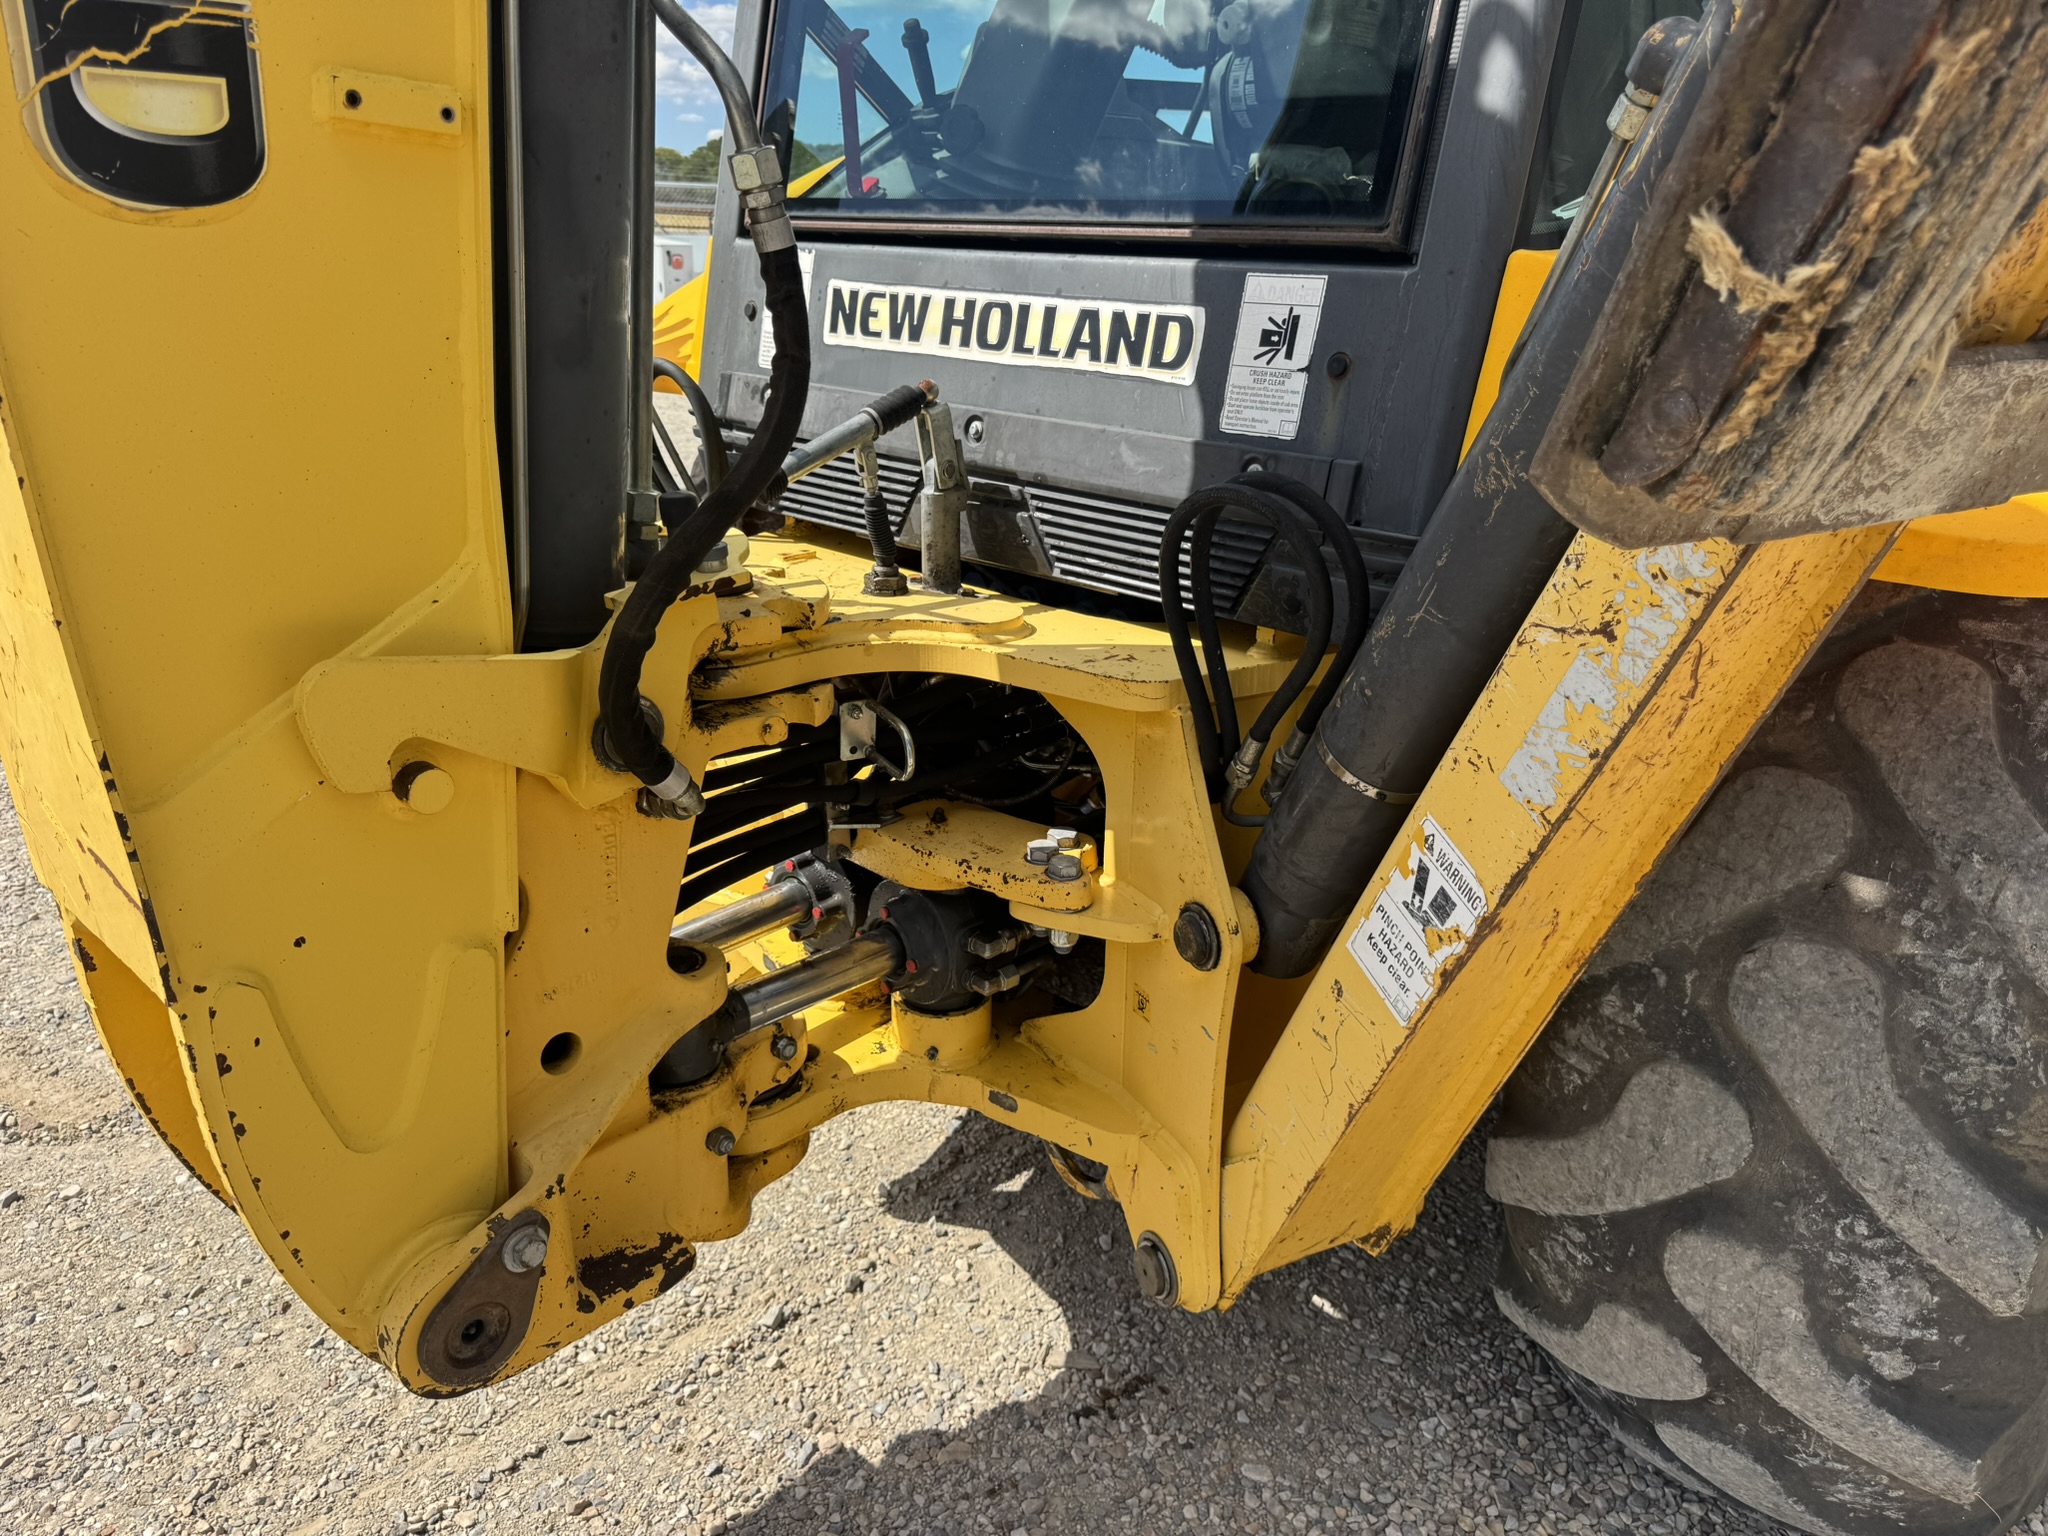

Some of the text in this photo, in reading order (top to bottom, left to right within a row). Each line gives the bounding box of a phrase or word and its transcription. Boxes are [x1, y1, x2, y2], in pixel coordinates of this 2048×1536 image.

[1267, 285, 1319, 303] DANGER
[828, 287, 1194, 371] NEW HOLLAND
[1249, 369, 1292, 380] CRUSH HAZARD
[1435, 848, 1482, 912] WARNING
[1366, 932, 1388, 965] Keep
[1378, 927, 1414, 979] HAZARD
